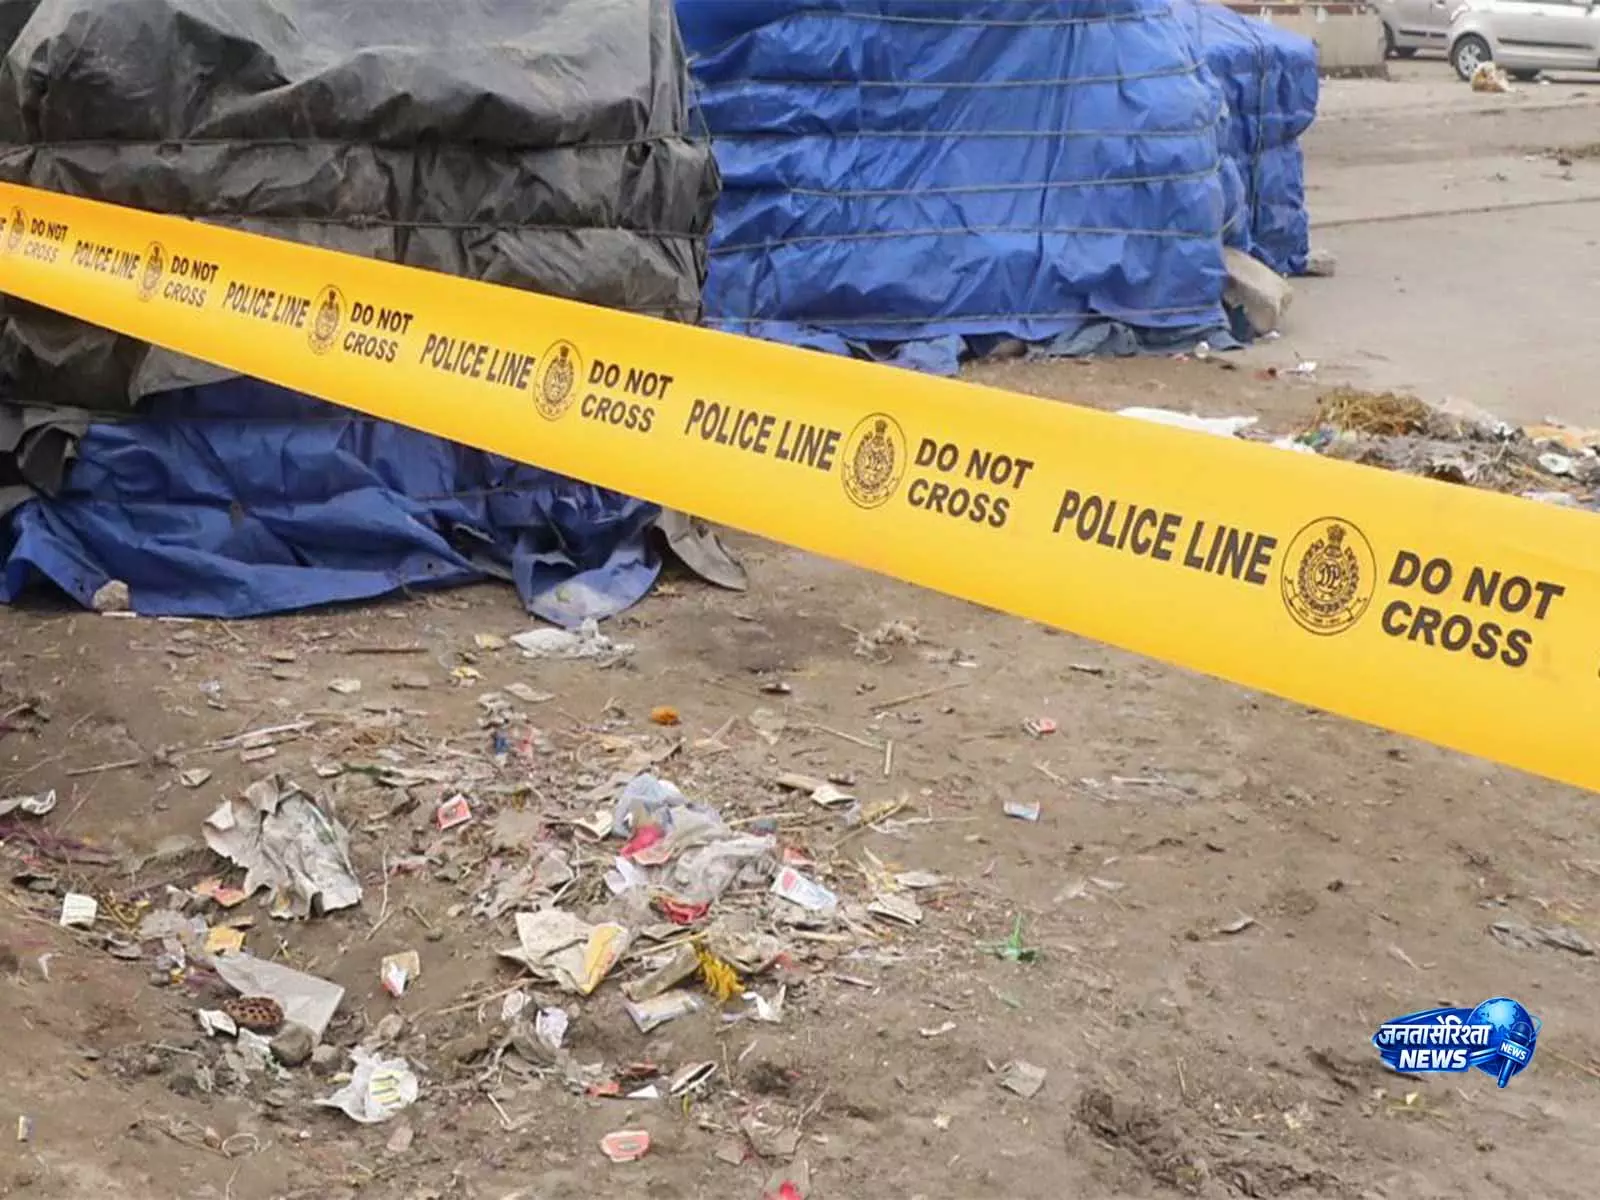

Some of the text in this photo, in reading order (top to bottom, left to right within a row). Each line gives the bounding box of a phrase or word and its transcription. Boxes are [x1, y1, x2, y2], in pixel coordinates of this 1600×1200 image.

[31, 217, 46, 237] DO
[46, 221, 69, 242] NOT
[71, 239, 141, 280] POLICE LINE
[171, 255, 219, 284] DO NOT
[163, 282, 208, 308] CROSS
[222, 280, 312, 328] POLICE LINE
[351, 302, 415, 335] DO NOT
[343, 331, 399, 363] CROSS
[420, 333, 536, 390] POLICE LINE
[588, 360, 675, 400] DO NOT
[580, 394, 656, 433] CROSS
[684, 398, 842, 472] POLICE LINE
[914, 437, 1035, 490] DO NOT
[907, 478, 1011, 529] CROSS
[1053, 489, 1279, 586] POLICE LINE
[1388, 549, 1566, 621] DO NOT
[1380, 599, 1533, 669] CROSS
